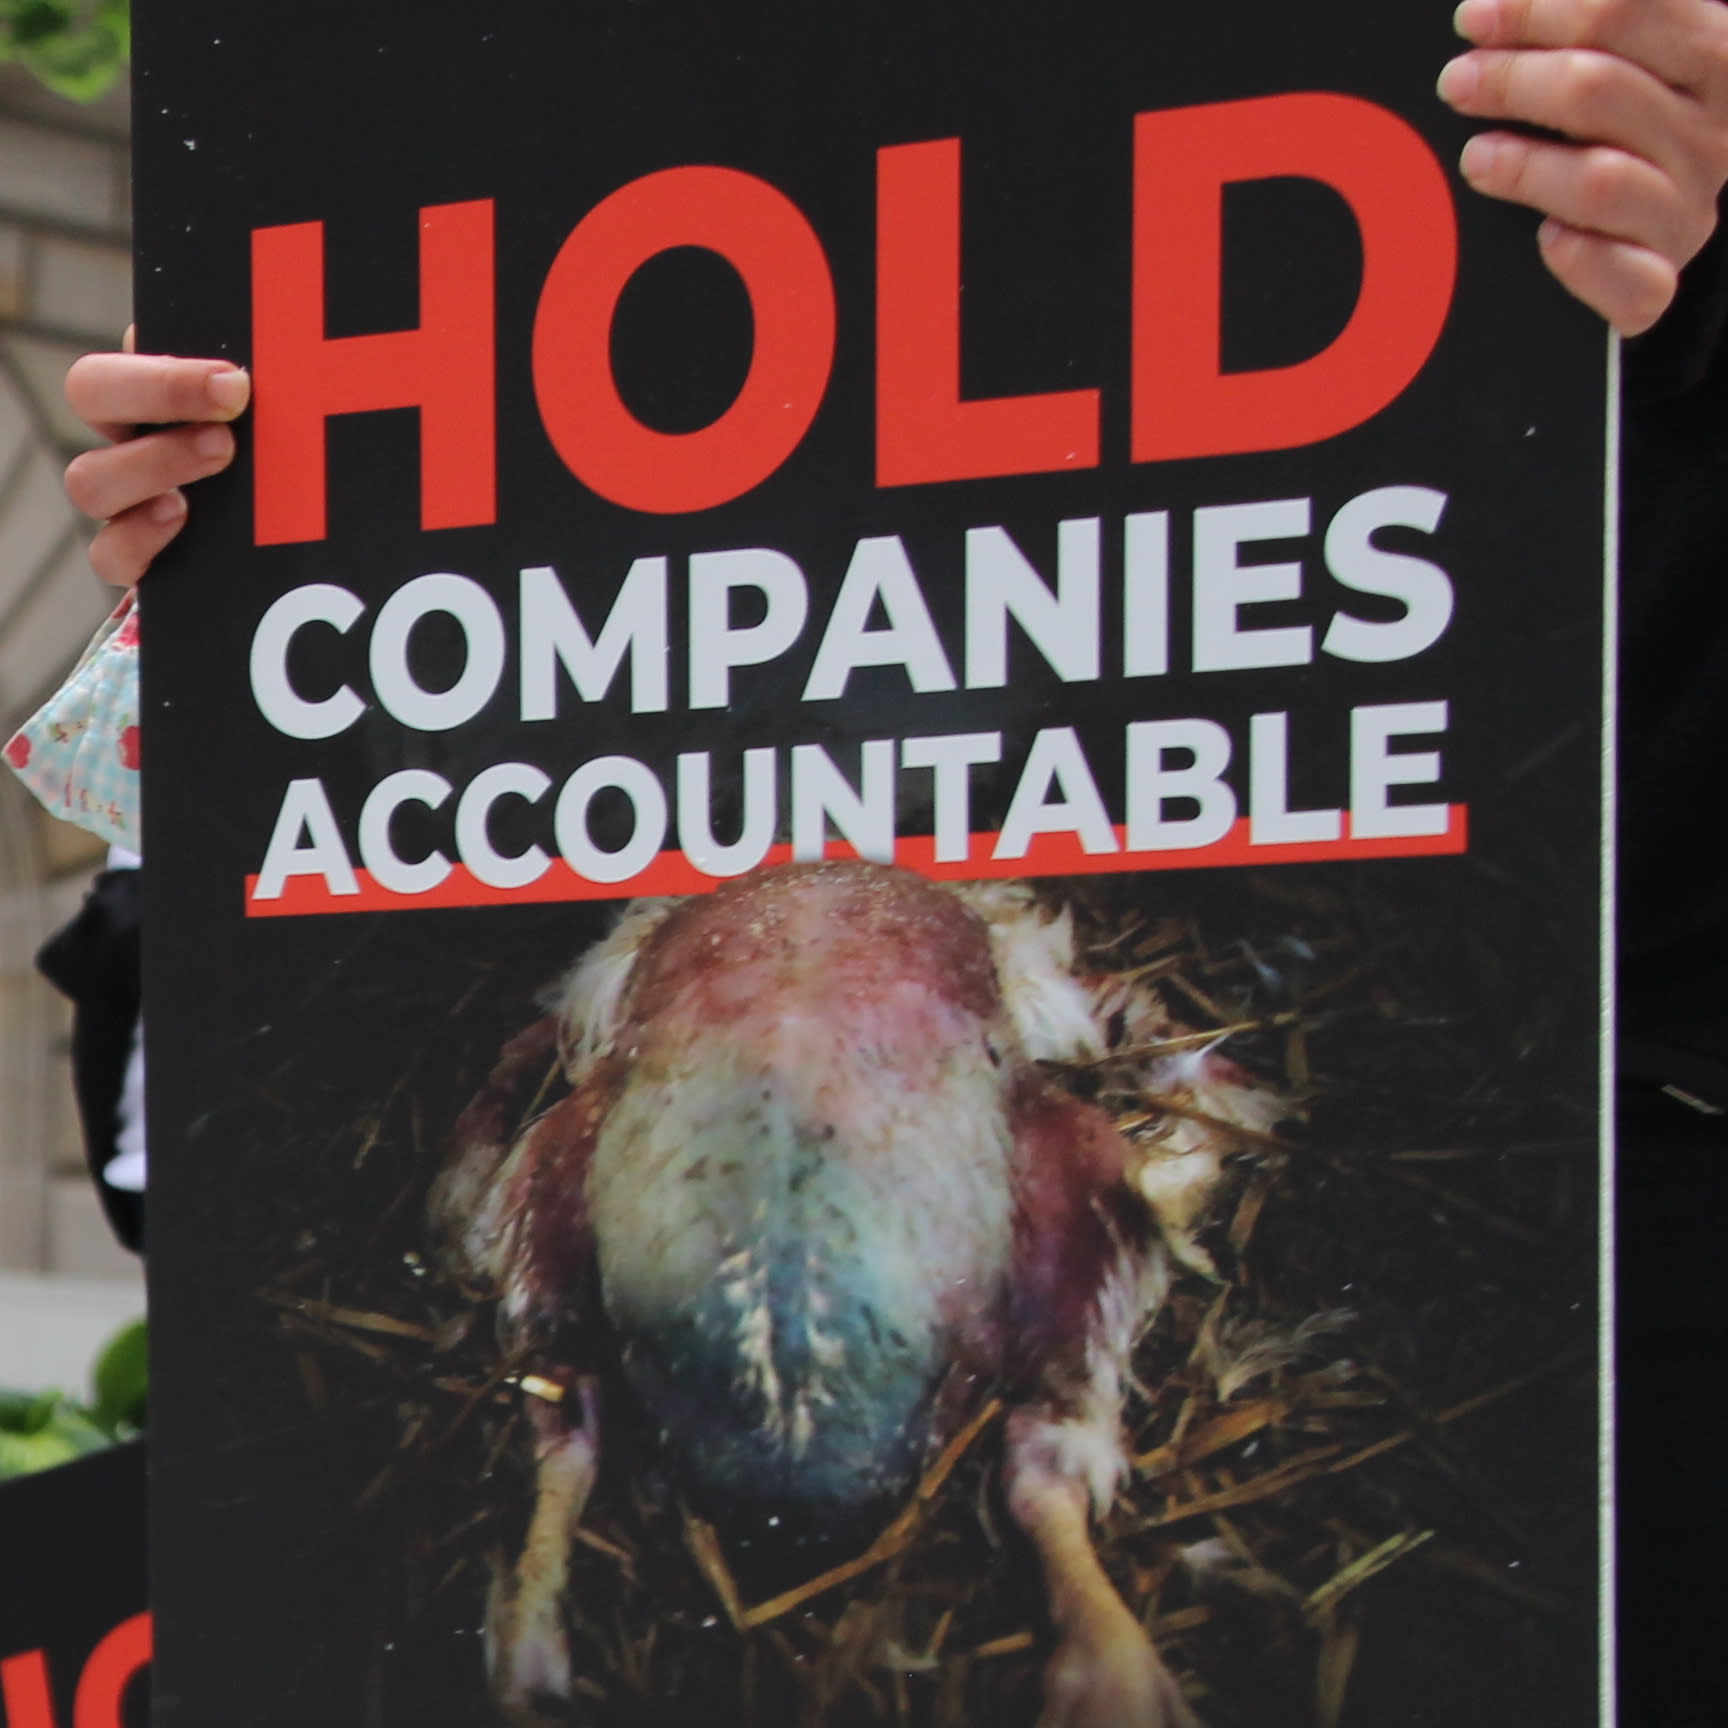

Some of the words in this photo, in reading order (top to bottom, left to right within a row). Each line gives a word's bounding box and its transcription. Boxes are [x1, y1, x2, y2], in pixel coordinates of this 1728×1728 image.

[250, 91, 1459, 548] HOLD
[248, 486, 1455, 742] COMPANIES
[250, 701, 1449, 903] ACCOUNTABLE
